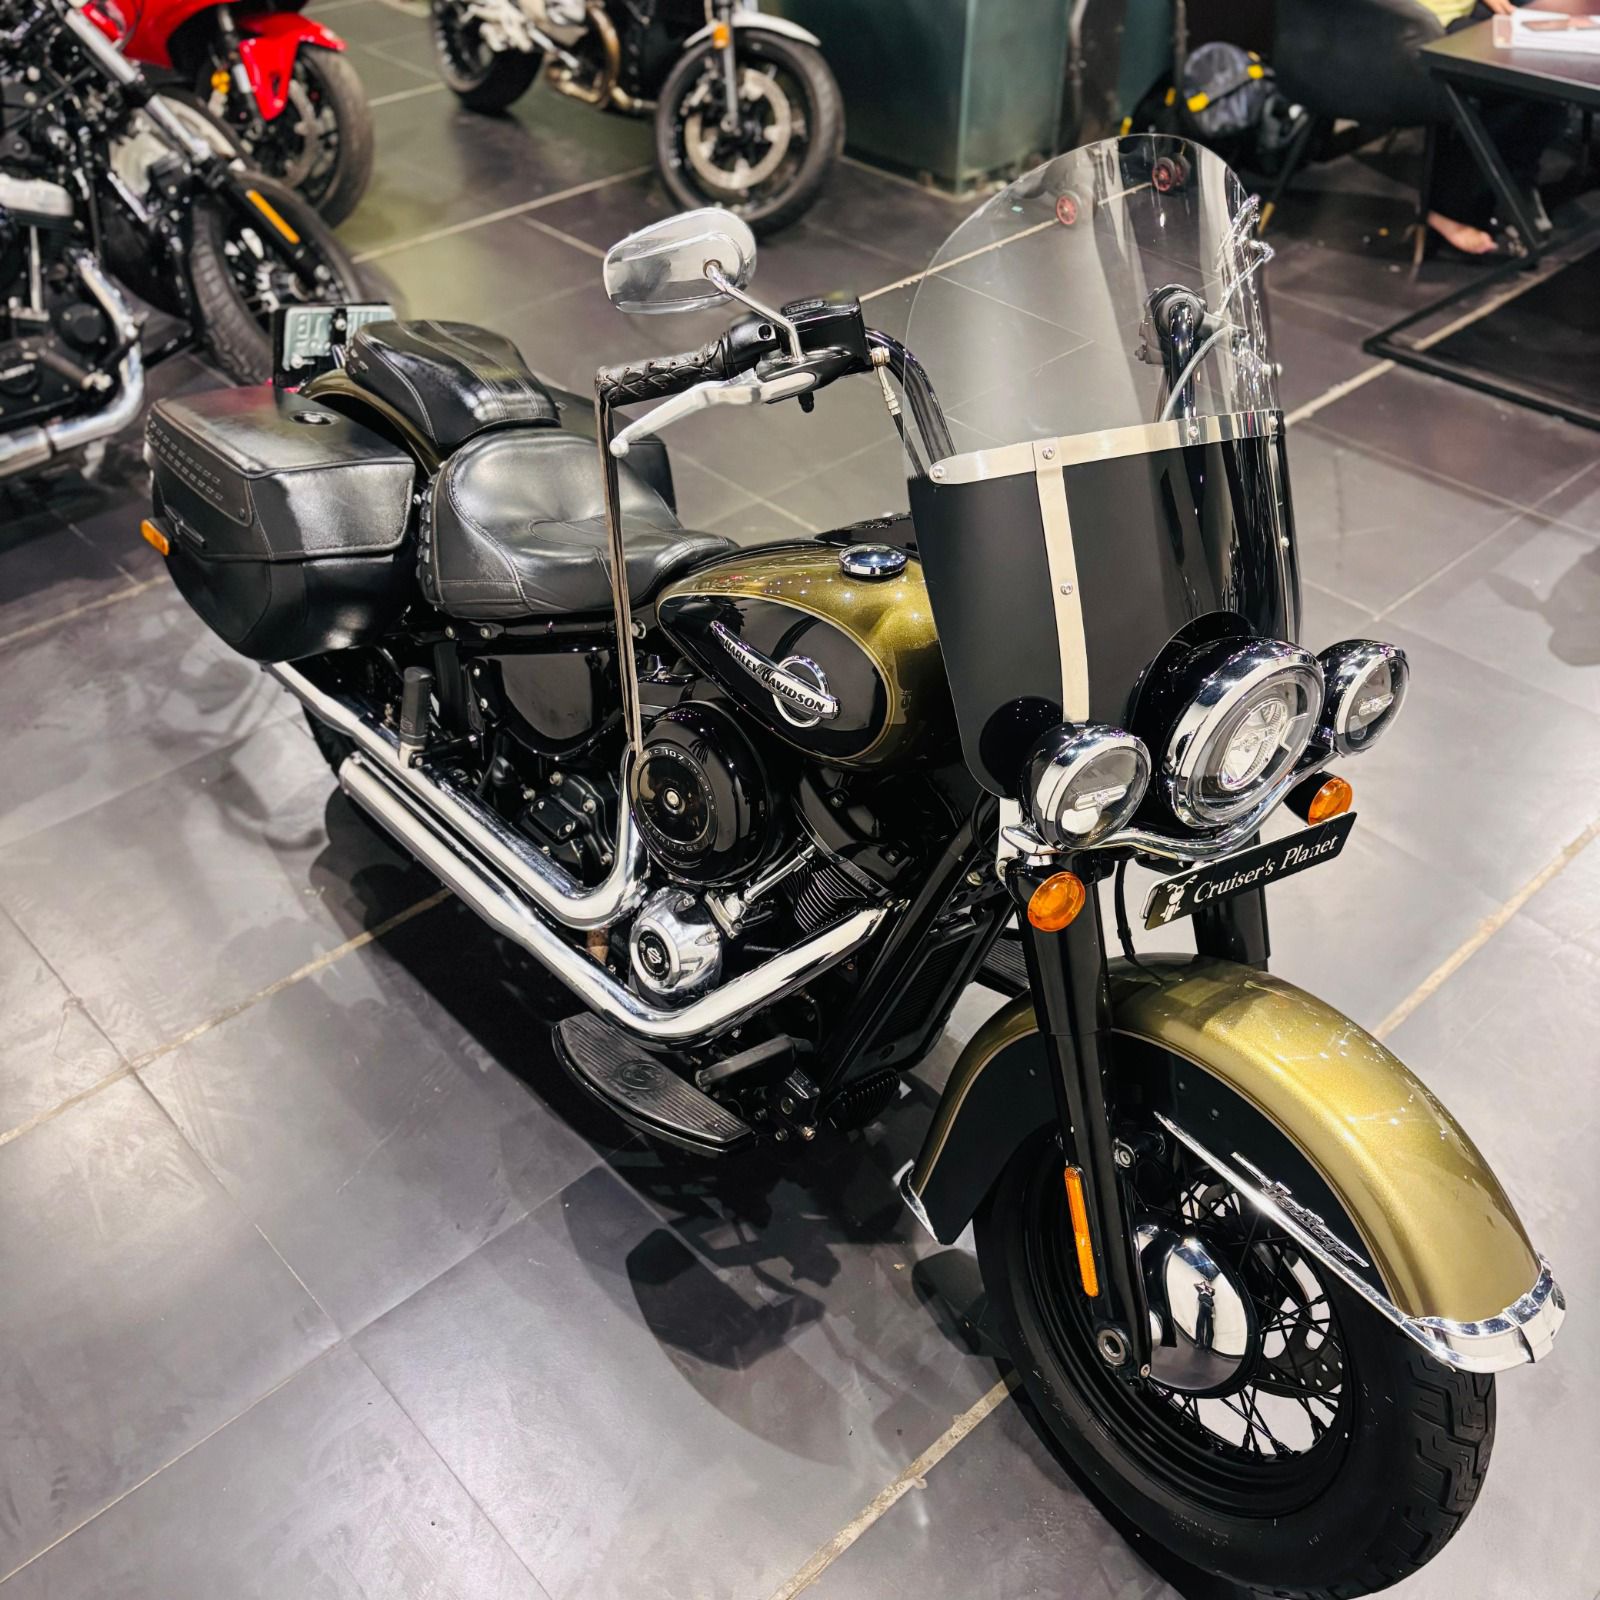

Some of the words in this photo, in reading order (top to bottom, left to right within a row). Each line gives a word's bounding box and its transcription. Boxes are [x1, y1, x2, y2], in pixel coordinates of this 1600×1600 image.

[723, 638, 761, 677] HARLEY
[760, 670, 826, 713] DAVIDSON
[664, 748, 684, 761] 107
[1193, 858, 1276, 904] Cruiser's
[1279, 834, 1339, 871] Planet
